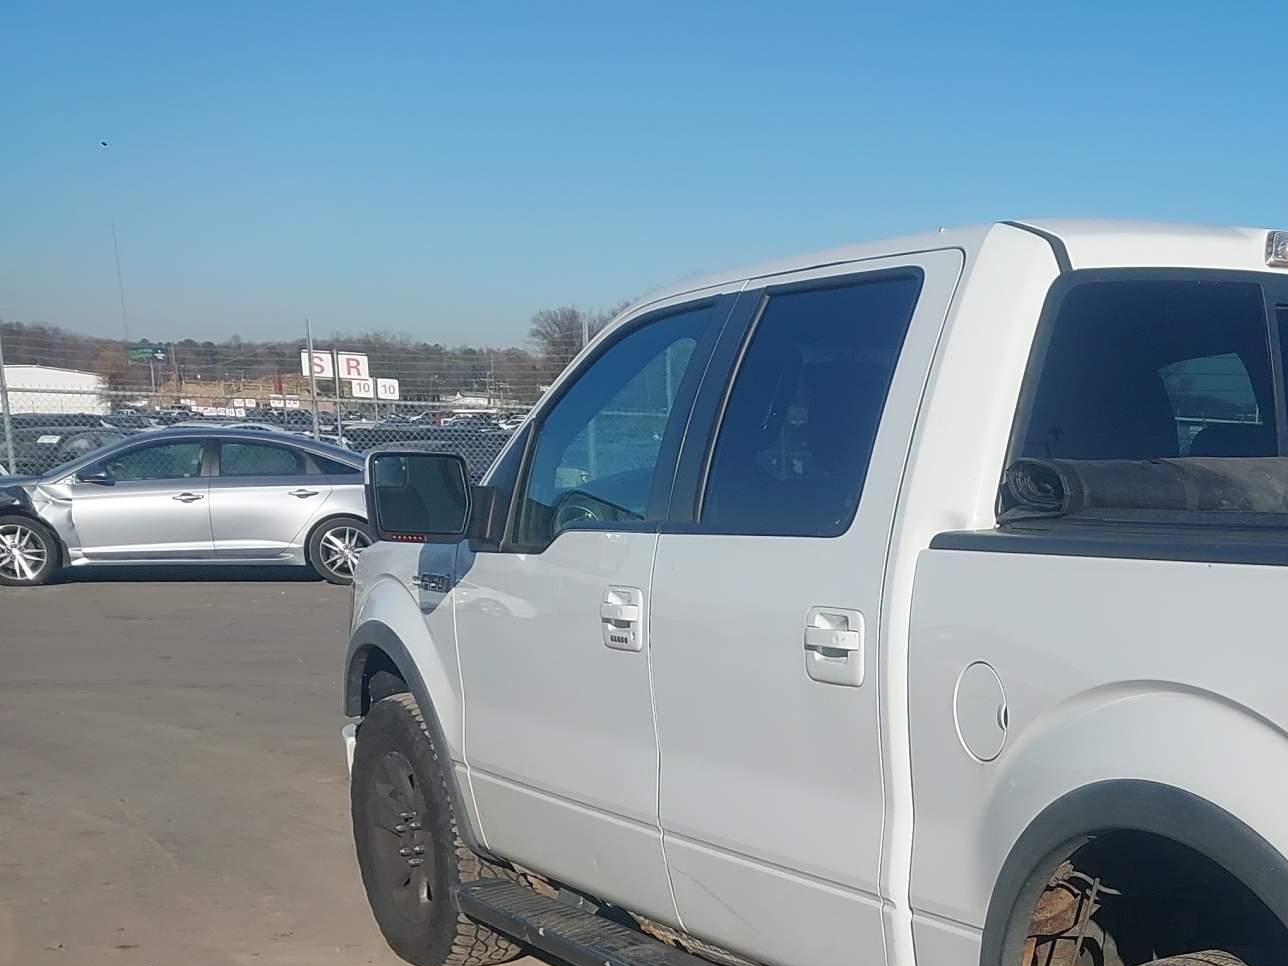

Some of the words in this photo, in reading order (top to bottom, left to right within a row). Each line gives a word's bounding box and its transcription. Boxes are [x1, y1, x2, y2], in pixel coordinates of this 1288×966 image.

[311, 355, 325, 375] S
[345, 357, 362, 377] R
[356, 382, 370, 393] 10
[381, 384, 396, 395] 10
